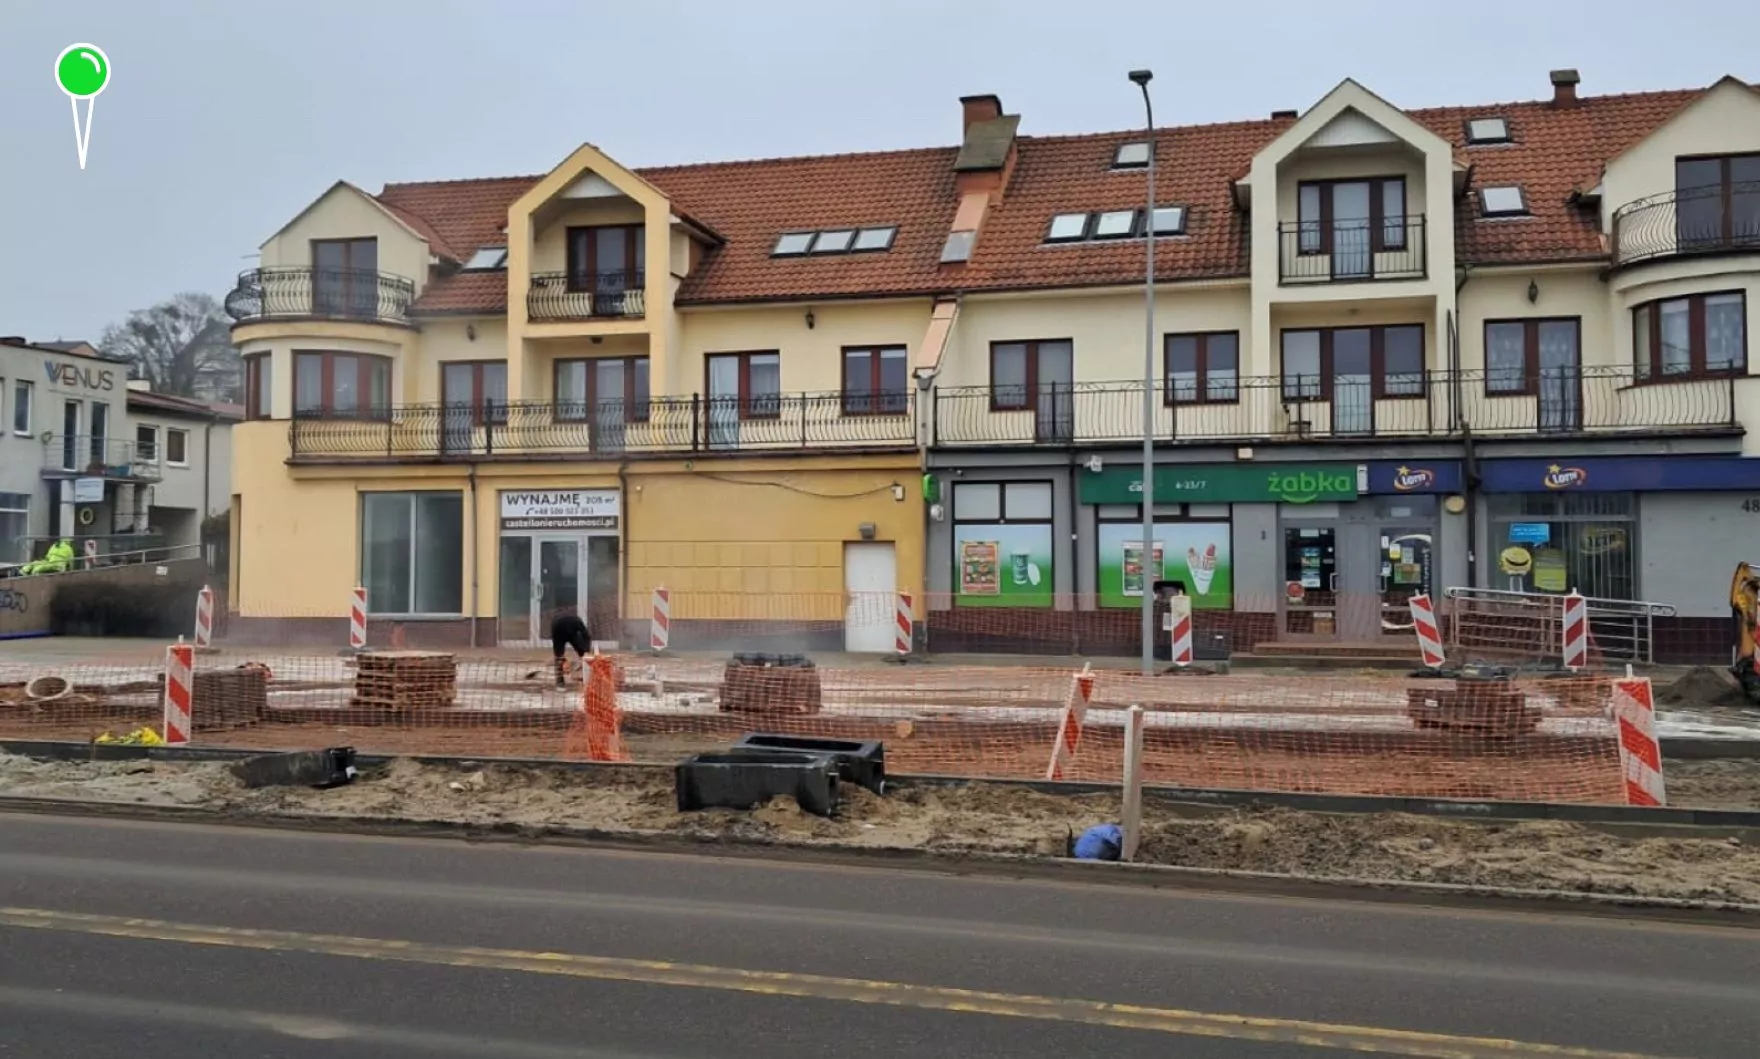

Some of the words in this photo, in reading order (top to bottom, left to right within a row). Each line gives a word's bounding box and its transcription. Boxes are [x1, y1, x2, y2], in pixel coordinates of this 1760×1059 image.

[45, 360, 114, 391] VENUS
[1268, 472, 1352, 492] żabka
[506, 493, 581, 507] WYNAJMĘ
